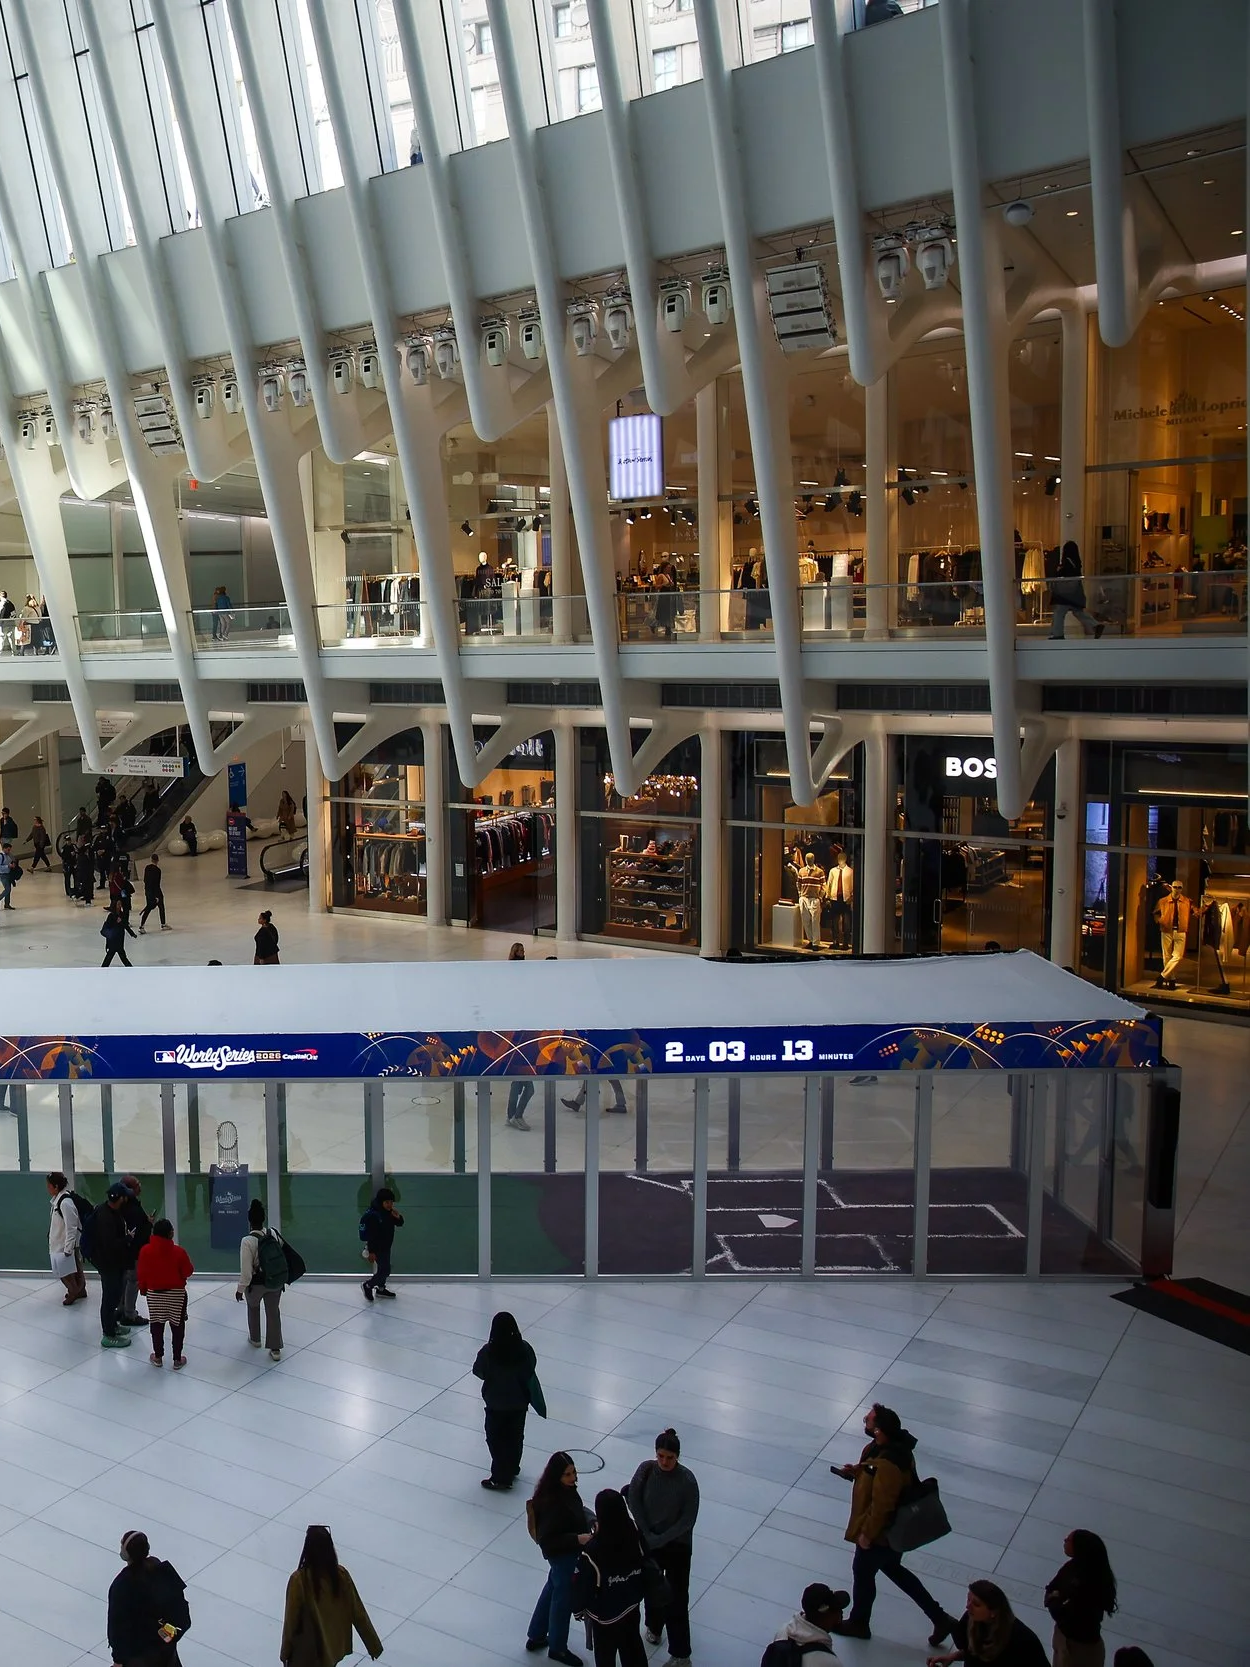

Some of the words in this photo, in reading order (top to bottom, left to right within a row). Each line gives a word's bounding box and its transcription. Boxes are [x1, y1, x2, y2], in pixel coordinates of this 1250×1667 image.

[1114, 405, 1167, 421] Michele
[946, 757, 997, 779] BOS
[175, 1044, 221, 1064] World
[213, 1046, 256, 1071] Series
[665, 1041, 683, 1062] 2
[709, 1041, 746, 1062] 03
[781, 1040, 813, 1061] 13
